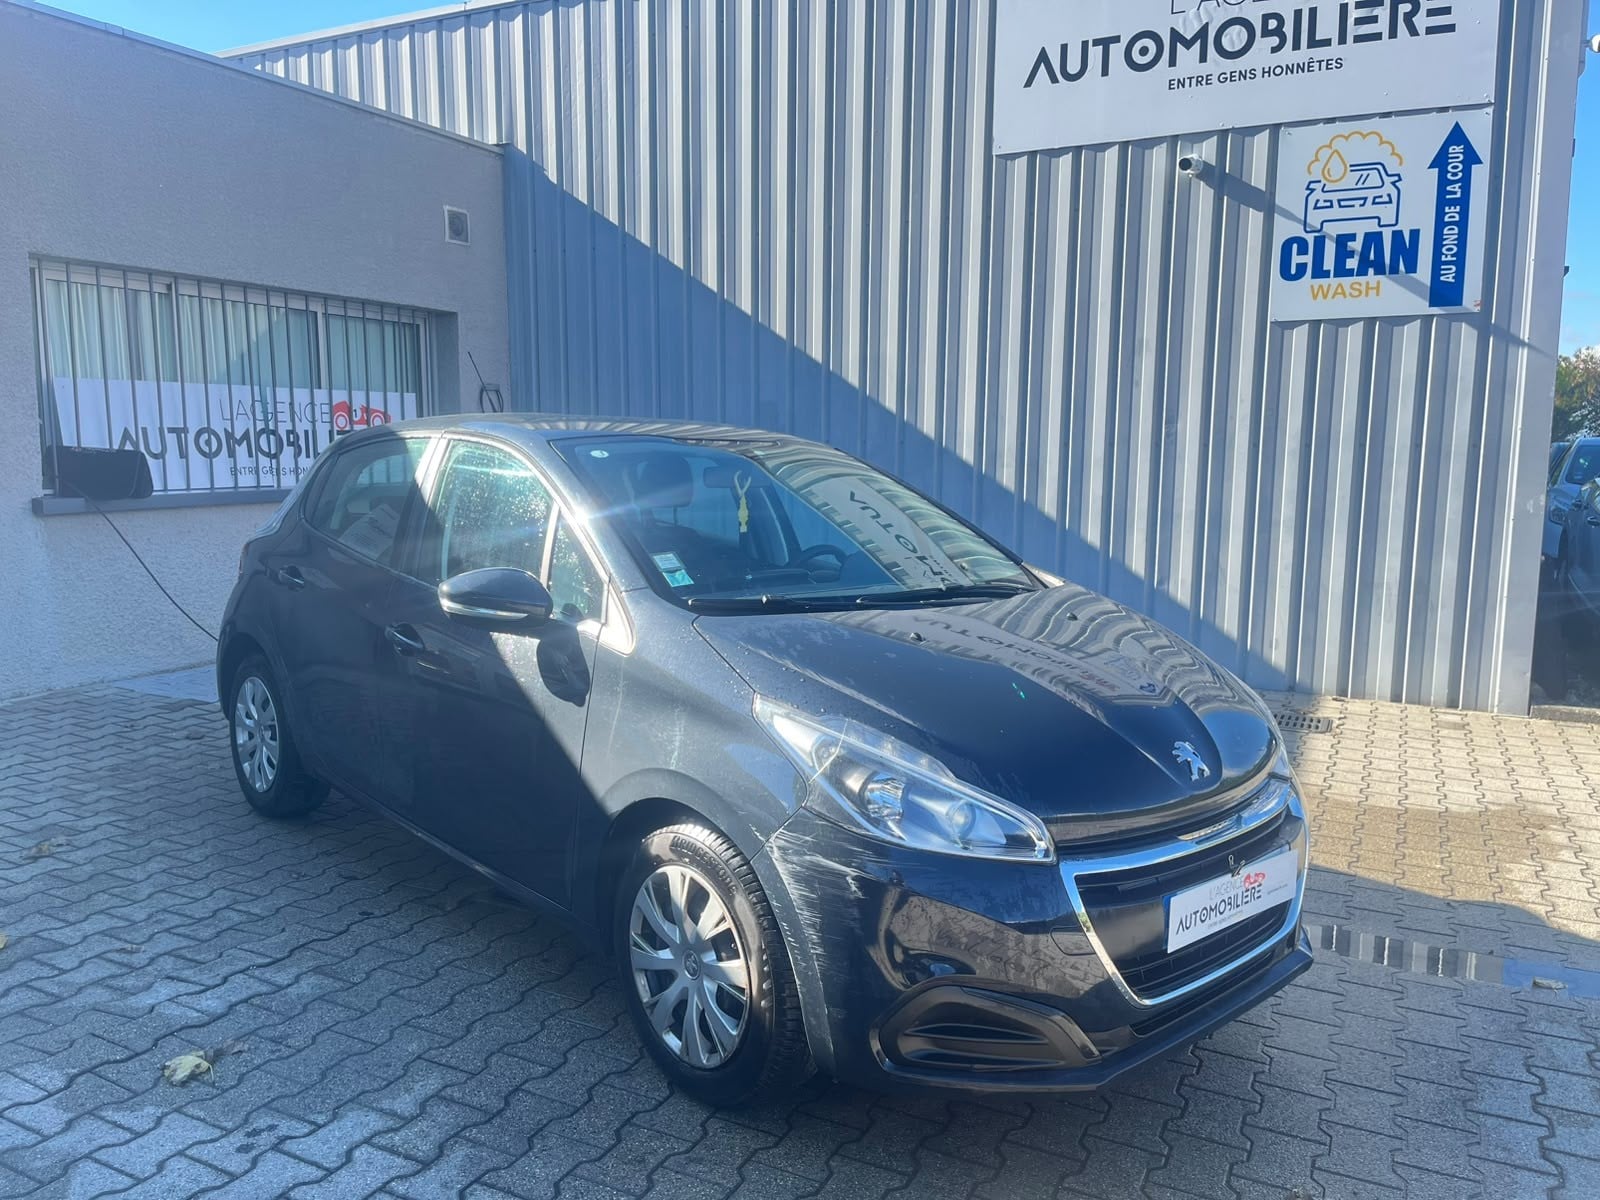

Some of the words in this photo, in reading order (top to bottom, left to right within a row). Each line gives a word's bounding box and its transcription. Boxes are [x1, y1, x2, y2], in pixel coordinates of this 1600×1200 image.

[1168, 73, 1213, 90] ENTRE
[1217, 68, 1257, 84] GENS
[1261, 57, 1344, 79] HONNÊTES
[1447, 144, 1464, 180] COUR
[1446, 183, 1462, 199] LA
[1444, 205, 1461, 222] DE
[1279, 228, 1420, 281] CLEAN
[1442, 225, 1459, 261] FOND
[1440, 264, 1456, 282] AU
[1310, 280, 1381, 301] WASH
